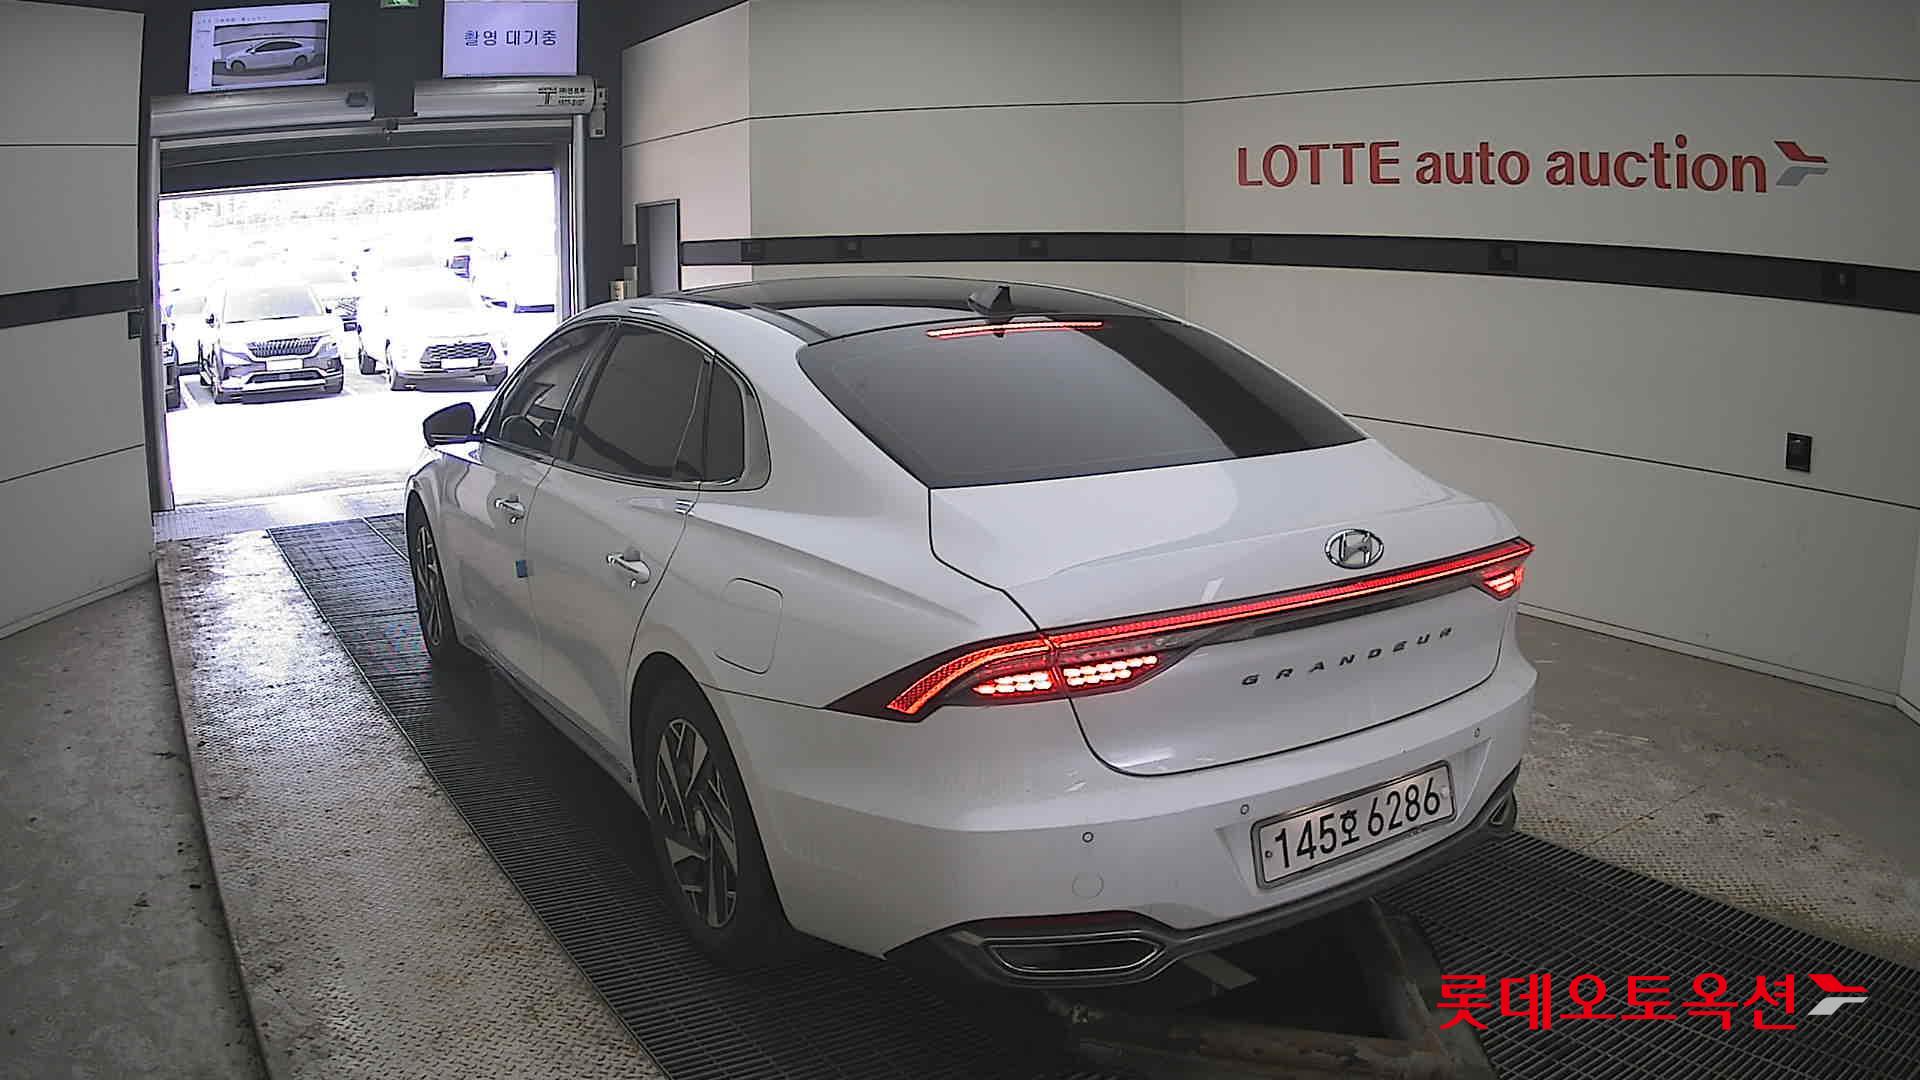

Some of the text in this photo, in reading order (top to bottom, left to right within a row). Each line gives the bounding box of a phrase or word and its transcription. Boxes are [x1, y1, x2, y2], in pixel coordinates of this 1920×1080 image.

[464, 30, 557, 46] 촬영 대기중
[1238, 134, 1767, 193] LOTTE auto auction
[1241, 626, 1453, 686] GRANDEUR
[1274, 777, 1441, 869] 145호 6286
